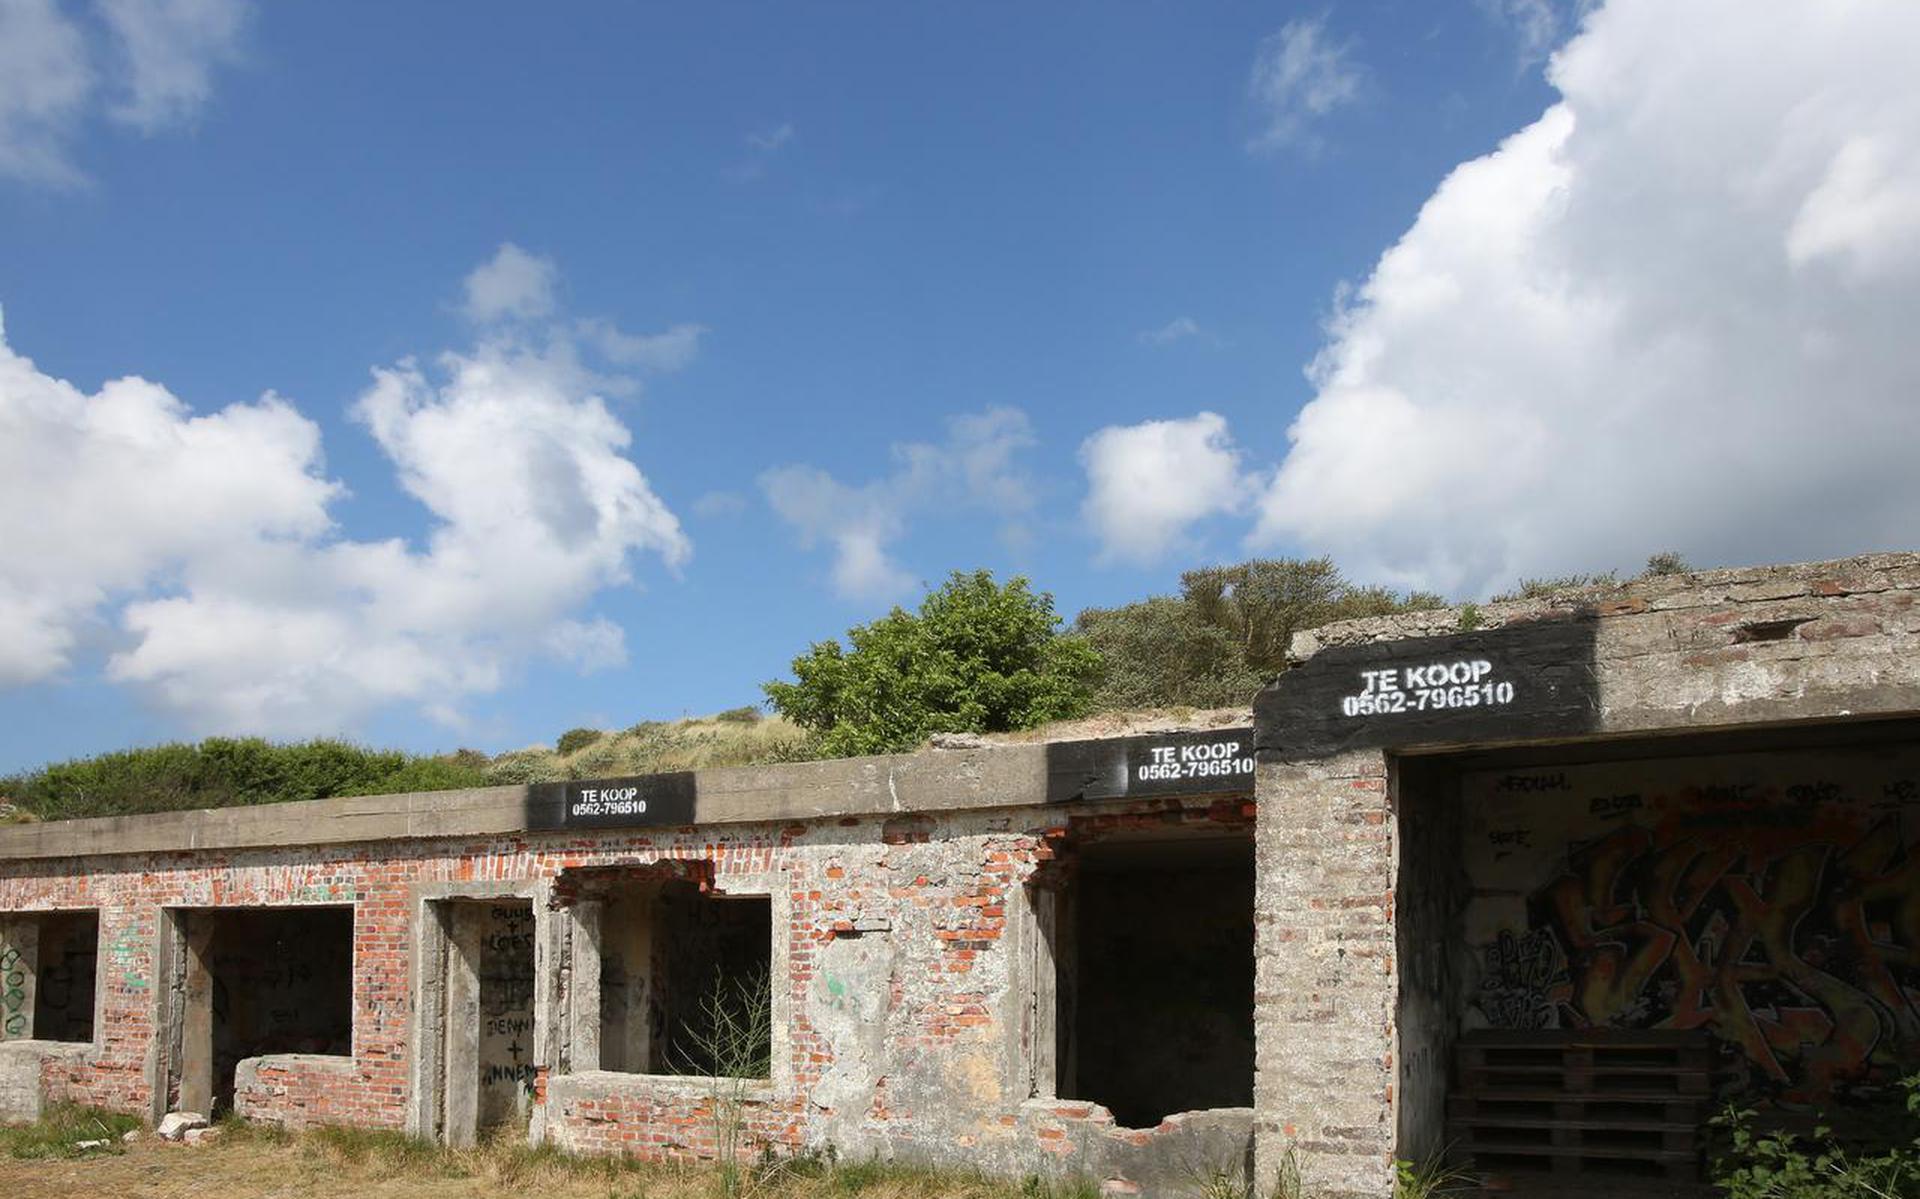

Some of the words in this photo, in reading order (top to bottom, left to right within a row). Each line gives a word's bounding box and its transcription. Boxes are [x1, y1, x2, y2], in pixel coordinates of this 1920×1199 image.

[1361, 669, 1398, 692] TE
[1406, 660, 1492, 689] KOOP
[1343, 681, 1515, 717] 0562-796510
[1151, 747, 1176, 763] TE
[1181, 742, 1240, 761] KOOP
[1138, 758, 1254, 780] 0562-796510
[581, 790, 597, 803] TE
[601, 788, 637, 802] KOOP
[572, 800, 647, 816] 0562-796510
